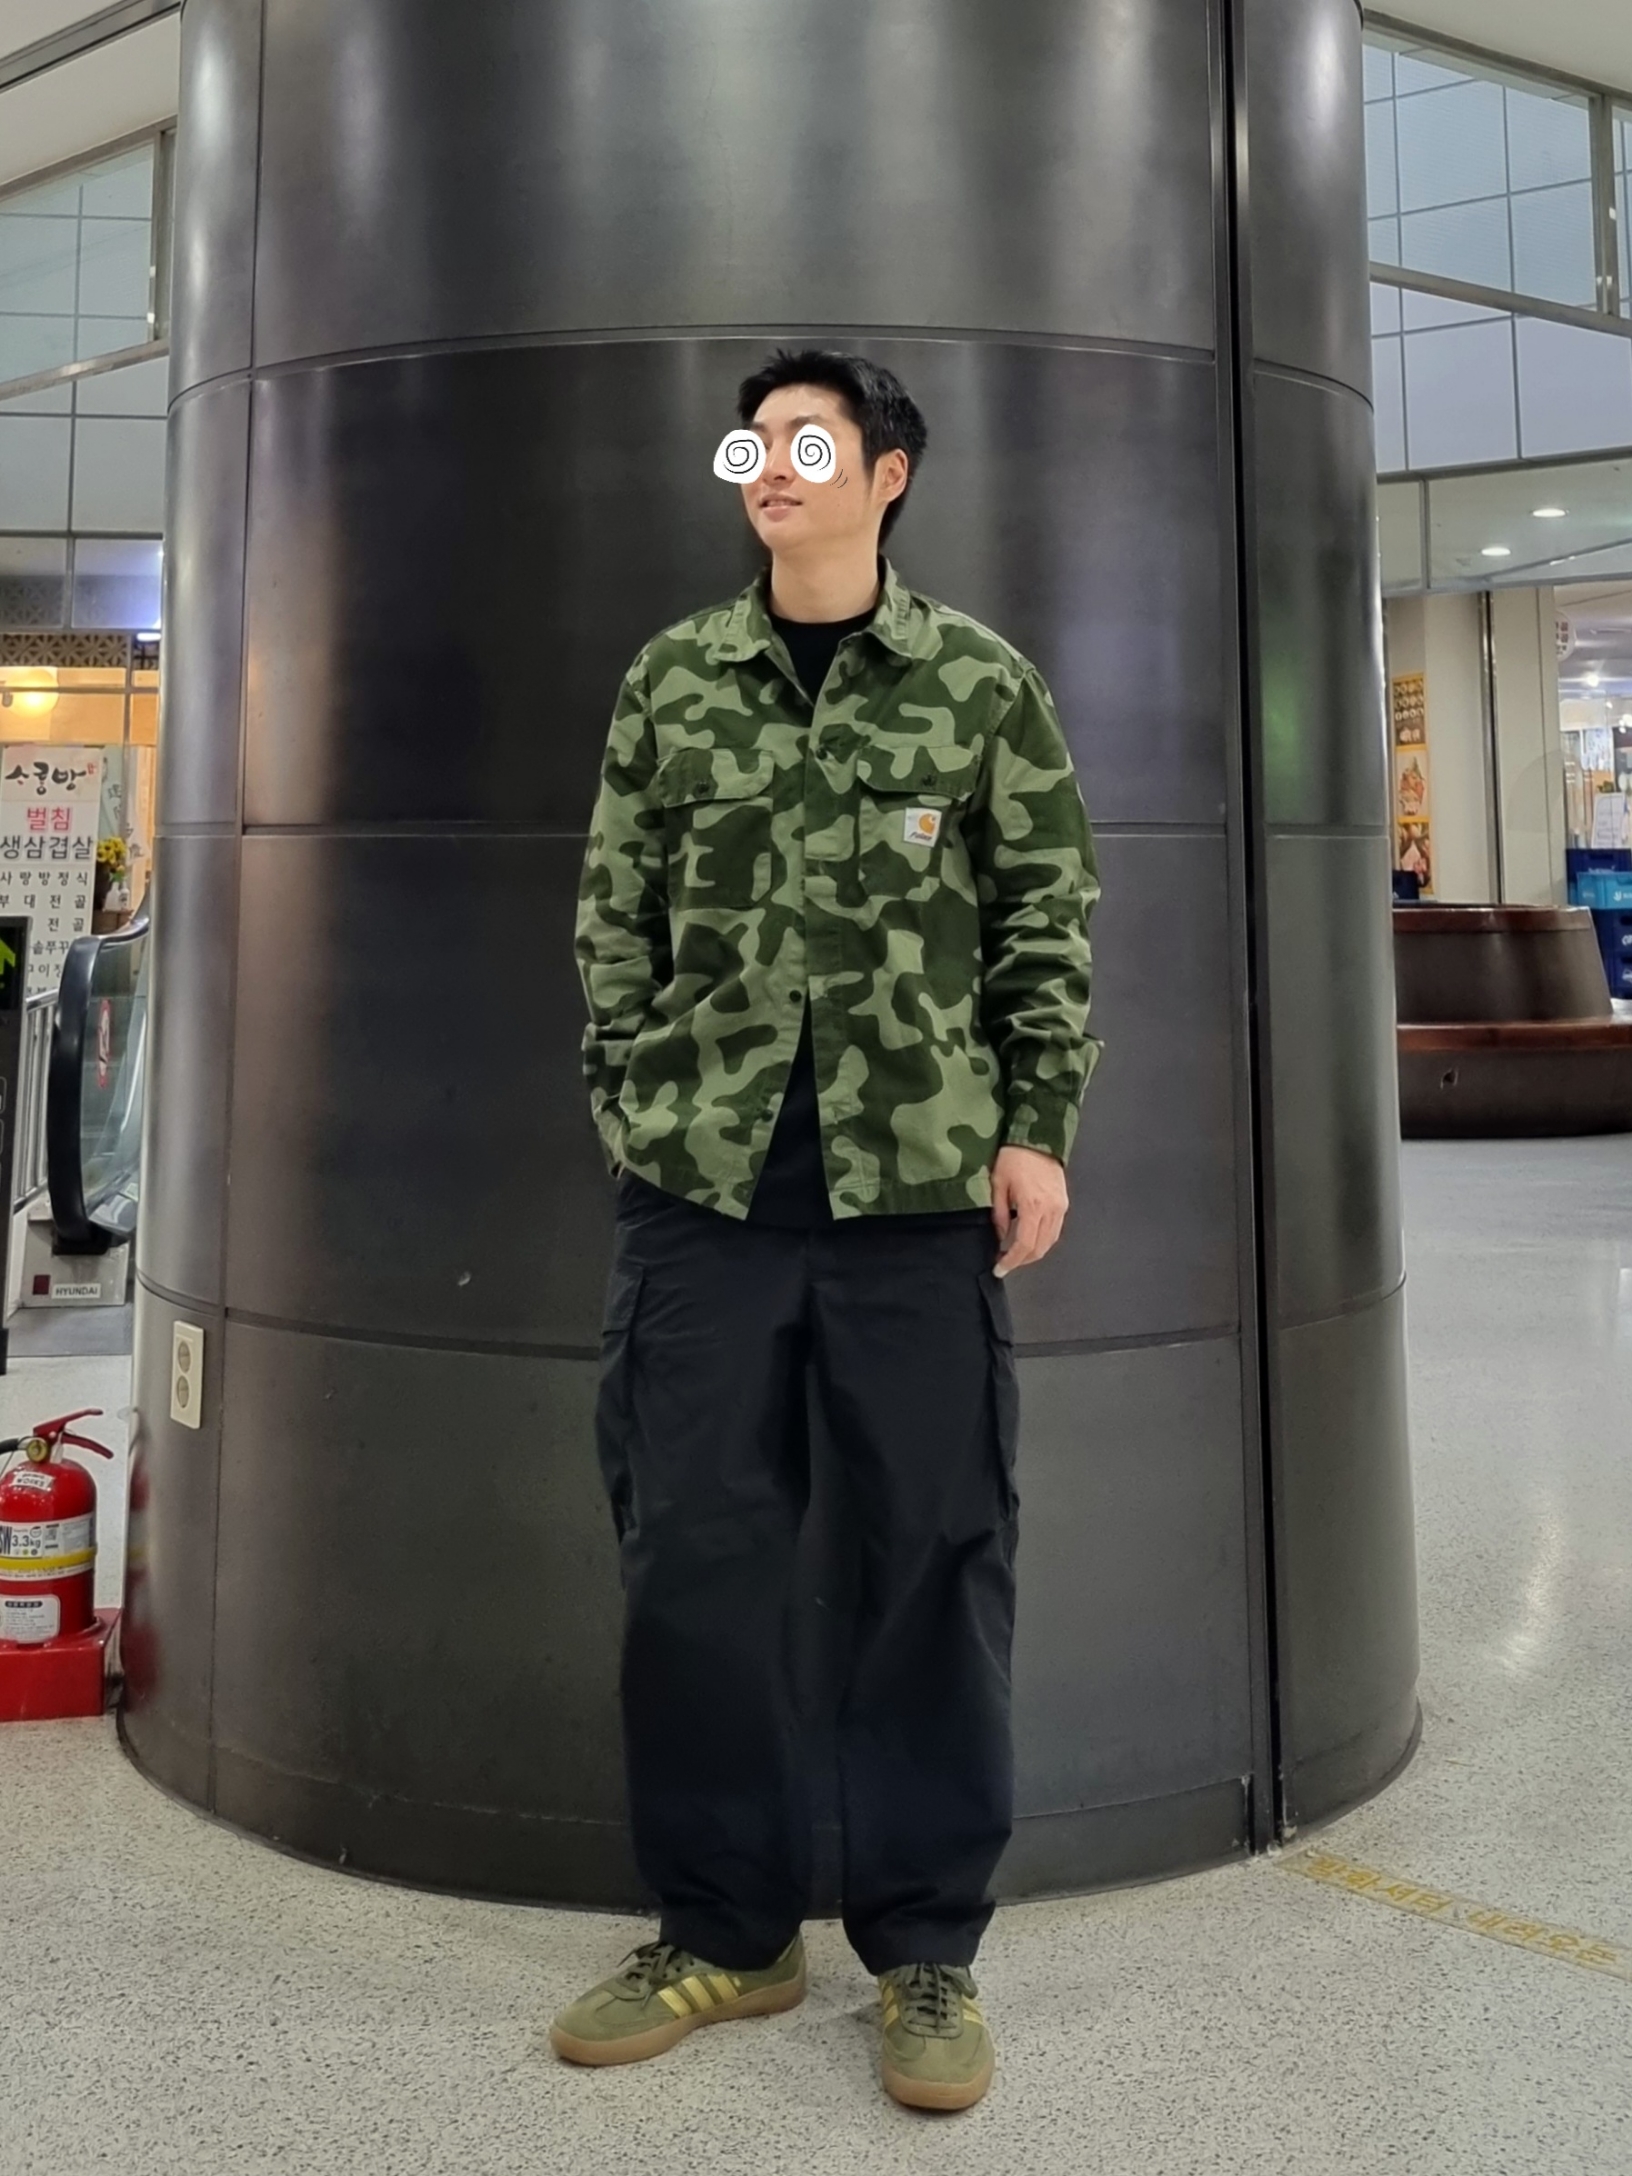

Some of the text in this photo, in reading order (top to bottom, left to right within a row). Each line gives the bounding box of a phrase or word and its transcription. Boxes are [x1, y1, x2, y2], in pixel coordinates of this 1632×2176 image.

[27, 807, 71, 831] 벌침
[0, 835, 93, 860] 생삼겹살
[55, 1287, 98, 1296] HYUNDAI
[12, 1535, 41, 1549] 3.3kg
[1306, 1855, 1455, 1913] 방화셔터
